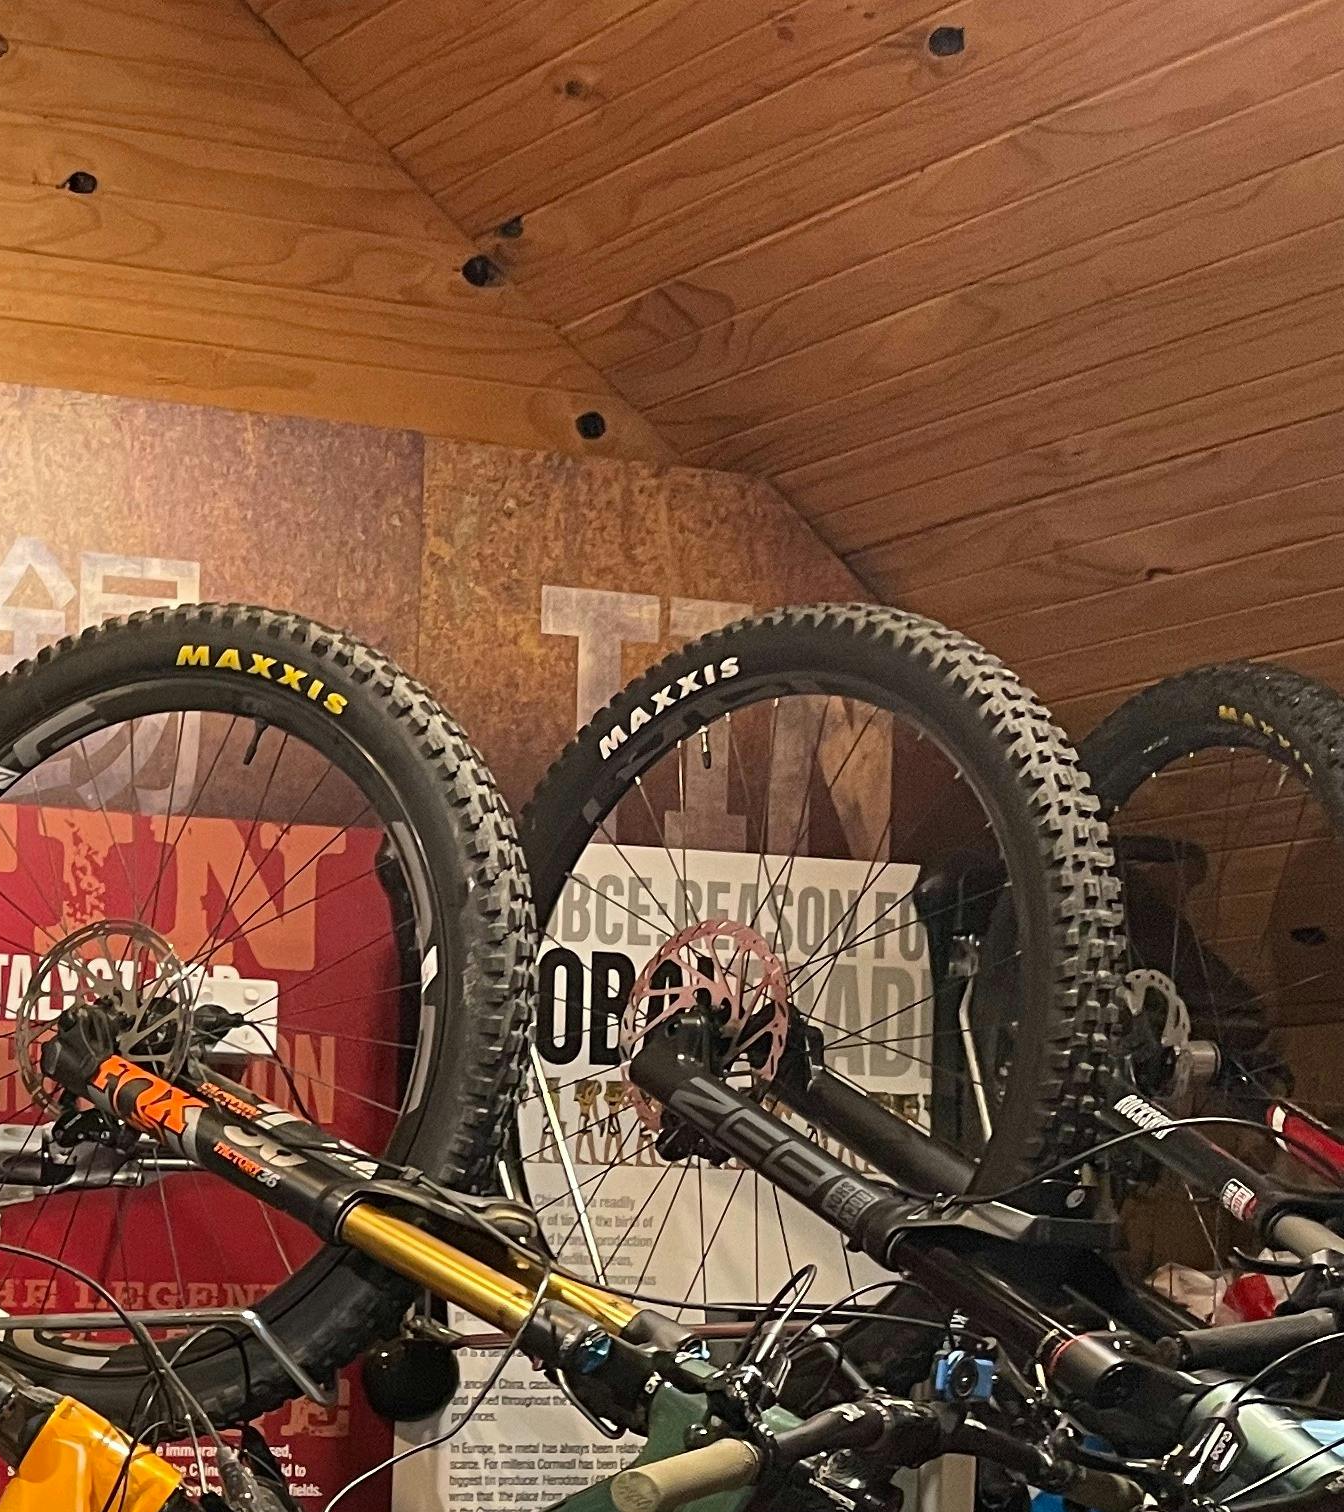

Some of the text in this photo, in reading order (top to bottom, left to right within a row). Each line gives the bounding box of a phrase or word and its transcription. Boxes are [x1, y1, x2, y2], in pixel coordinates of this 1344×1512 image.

[176, 645, 348, 716] MAXXIS
[599, 657, 739, 760] MAXXIS
[552, 873, 928, 963] BCE: REASON FO
[92, 1055, 209, 1136] FOX
